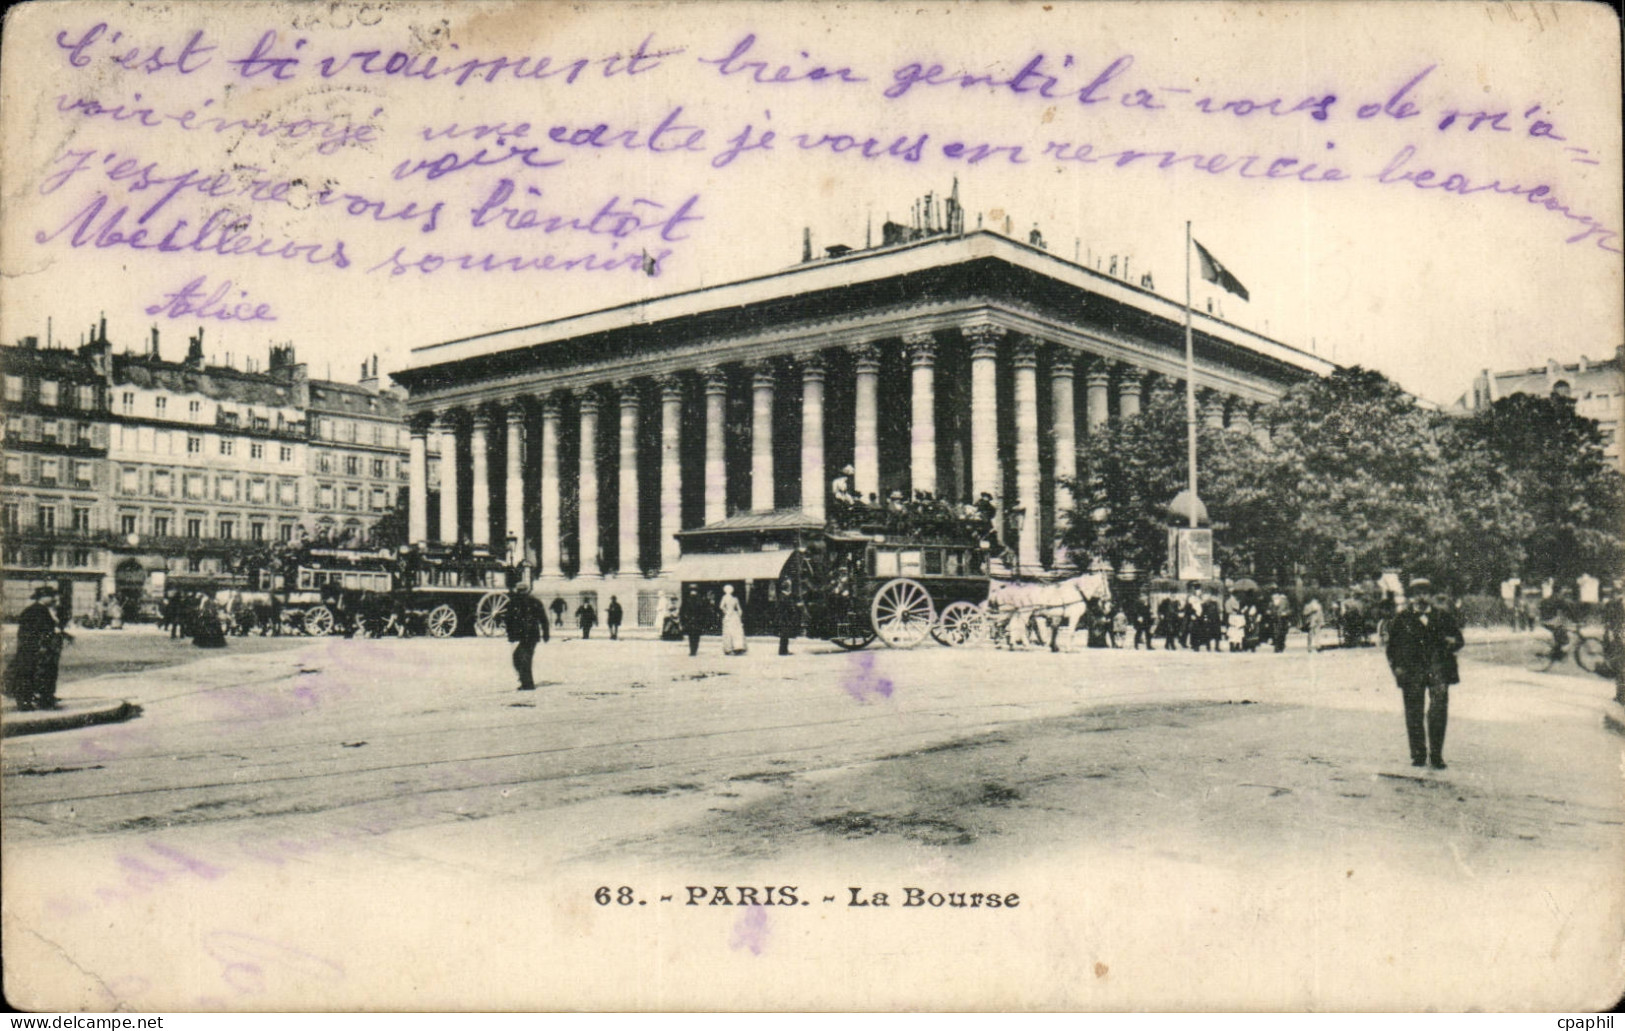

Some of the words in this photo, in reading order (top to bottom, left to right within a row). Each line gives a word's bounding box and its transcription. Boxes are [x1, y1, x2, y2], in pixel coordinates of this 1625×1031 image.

[698, 33, 868, 84] bien
[883, 53, 1134, 99] gentil
[1196, 92, 1337, 122] vous
[1356, 64, 1437, 120] de
[56, 92, 163, 128] voir
[422, 120, 532, 144] une
[549, 106, 706, 153] carte
[711, 110, 777, 168] je
[788, 132, 930, 163] vous
[942, 142, 1033, 166] en
[1040, 140, 1354, 183] remercie
[393, 142, 566, 181] voir
[317, 190, 445, 233] vous
[471, 178, 705, 242] bientôt
[145, 274, 279, 321] Alice
[594, 886, 648, 906] 68.
[685, 886, 810, 907] PARIS.
[847, 887, 890, 907] La
[902, 887, 1022, 908] Bourse
